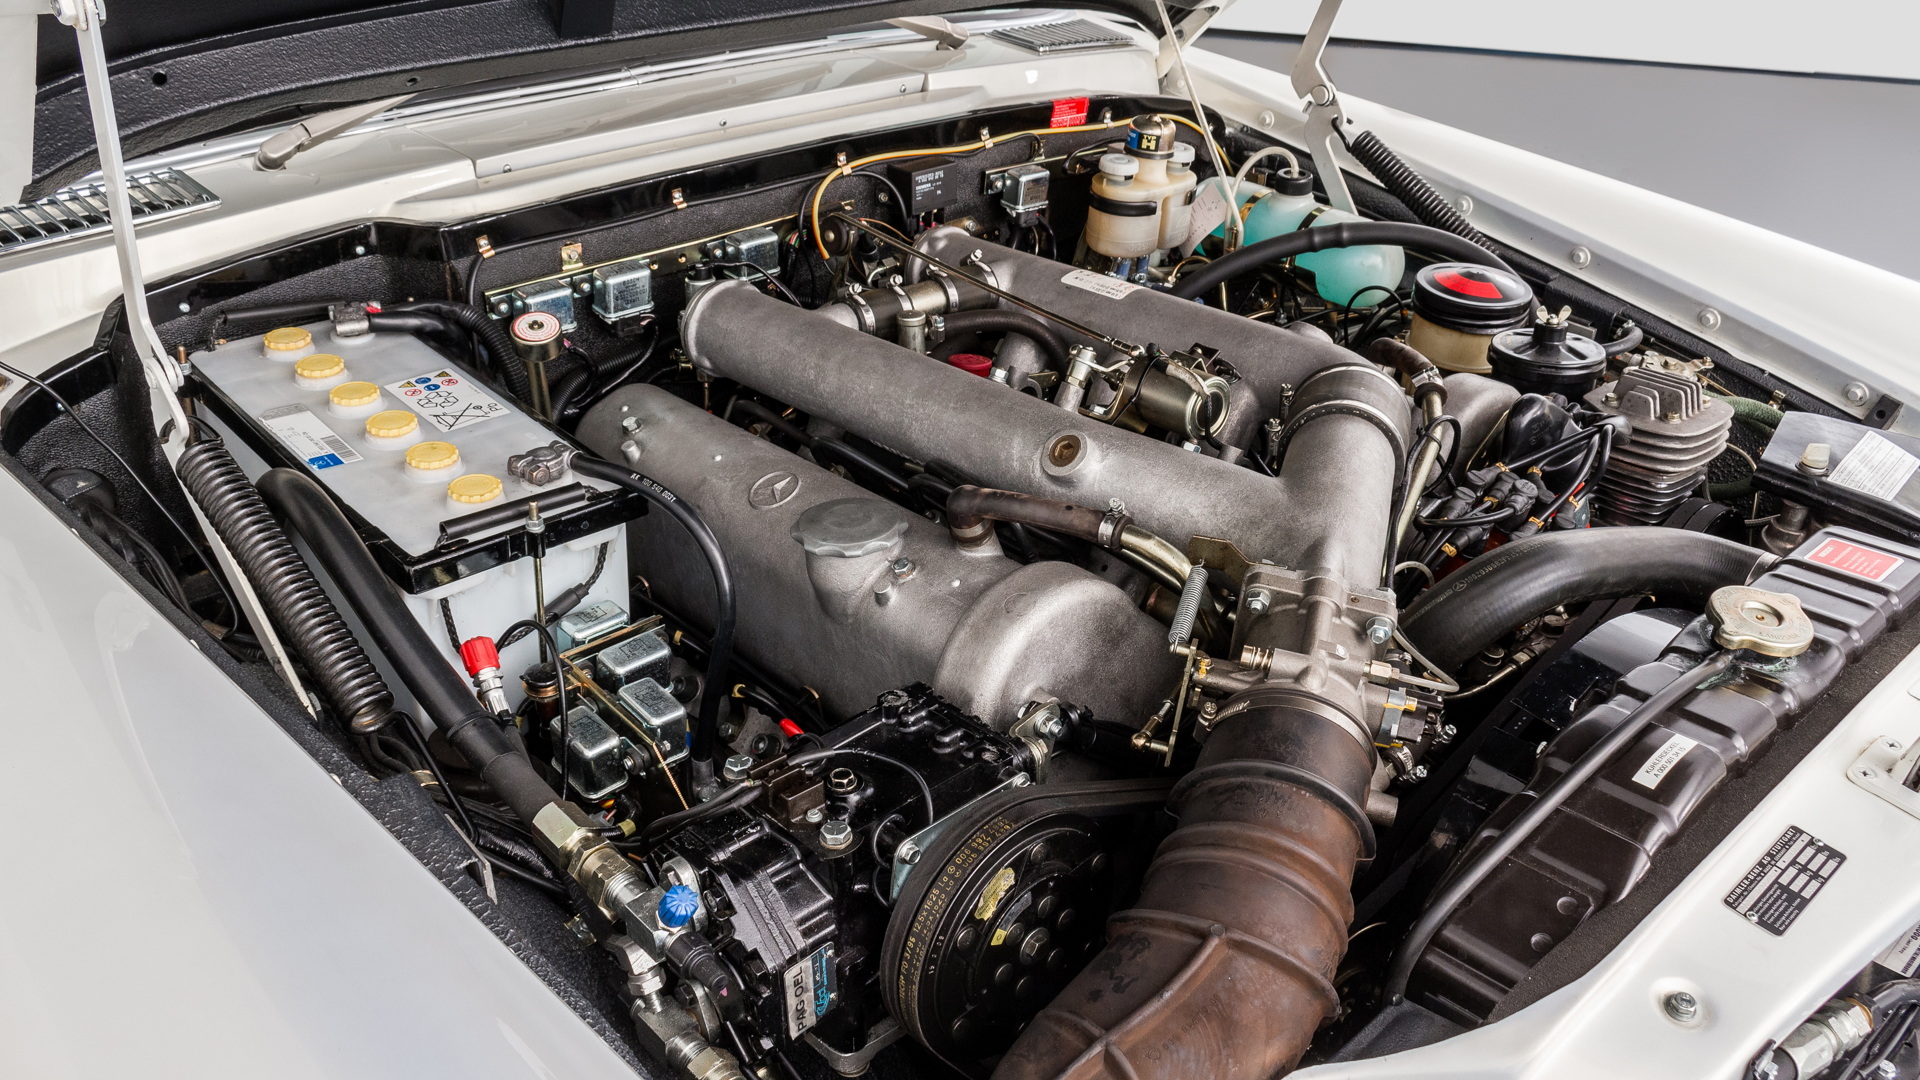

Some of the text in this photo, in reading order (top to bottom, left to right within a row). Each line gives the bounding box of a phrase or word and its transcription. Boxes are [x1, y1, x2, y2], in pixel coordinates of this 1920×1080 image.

[1770, 828, 1795, 854] STUTTGART
[955, 848, 971, 864] 006
[793, 967, 805, 1031] PAG OEL
